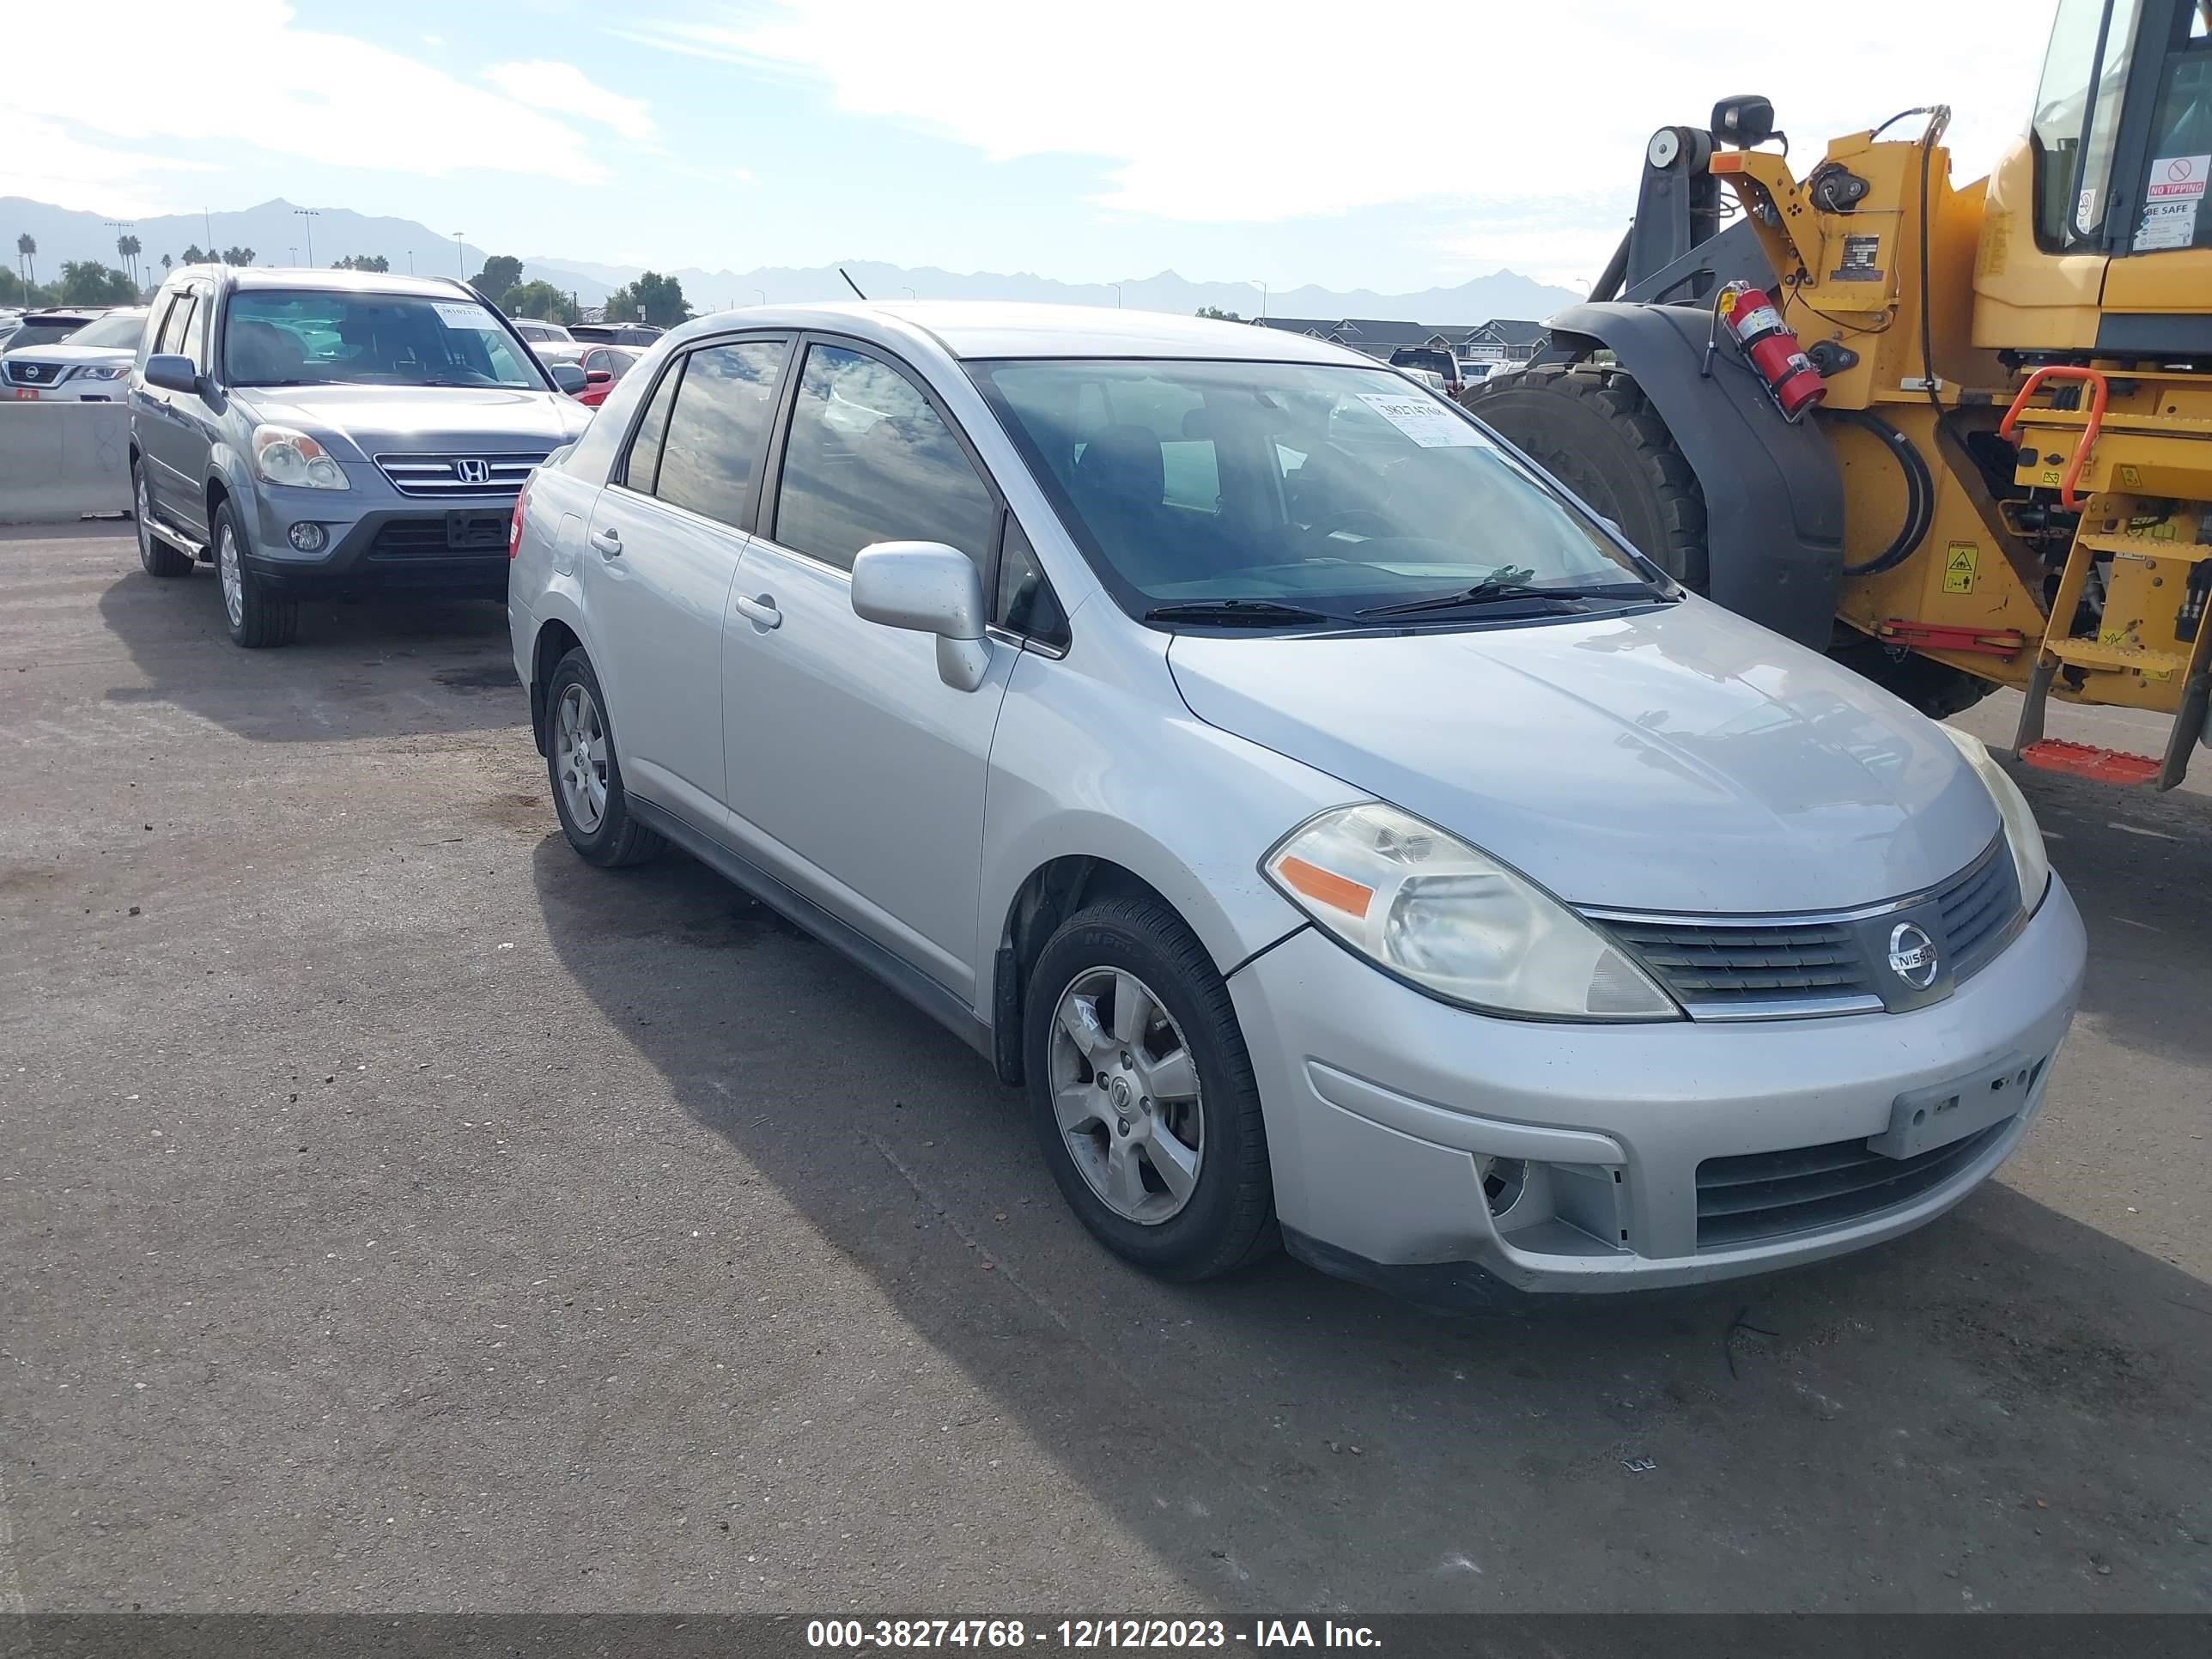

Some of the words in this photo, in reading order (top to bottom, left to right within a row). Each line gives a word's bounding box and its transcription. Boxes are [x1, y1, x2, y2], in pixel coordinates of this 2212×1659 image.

[2151, 185, 2164, 195] NO
[2166, 183, 2202, 194] TIPPING
[2146, 206, 2159, 216] BE
[2161, 204, 2188, 215] SAFE
[1380, 404, 1447, 416] 38274768
[1899, 949, 1936, 967] NISSAN
